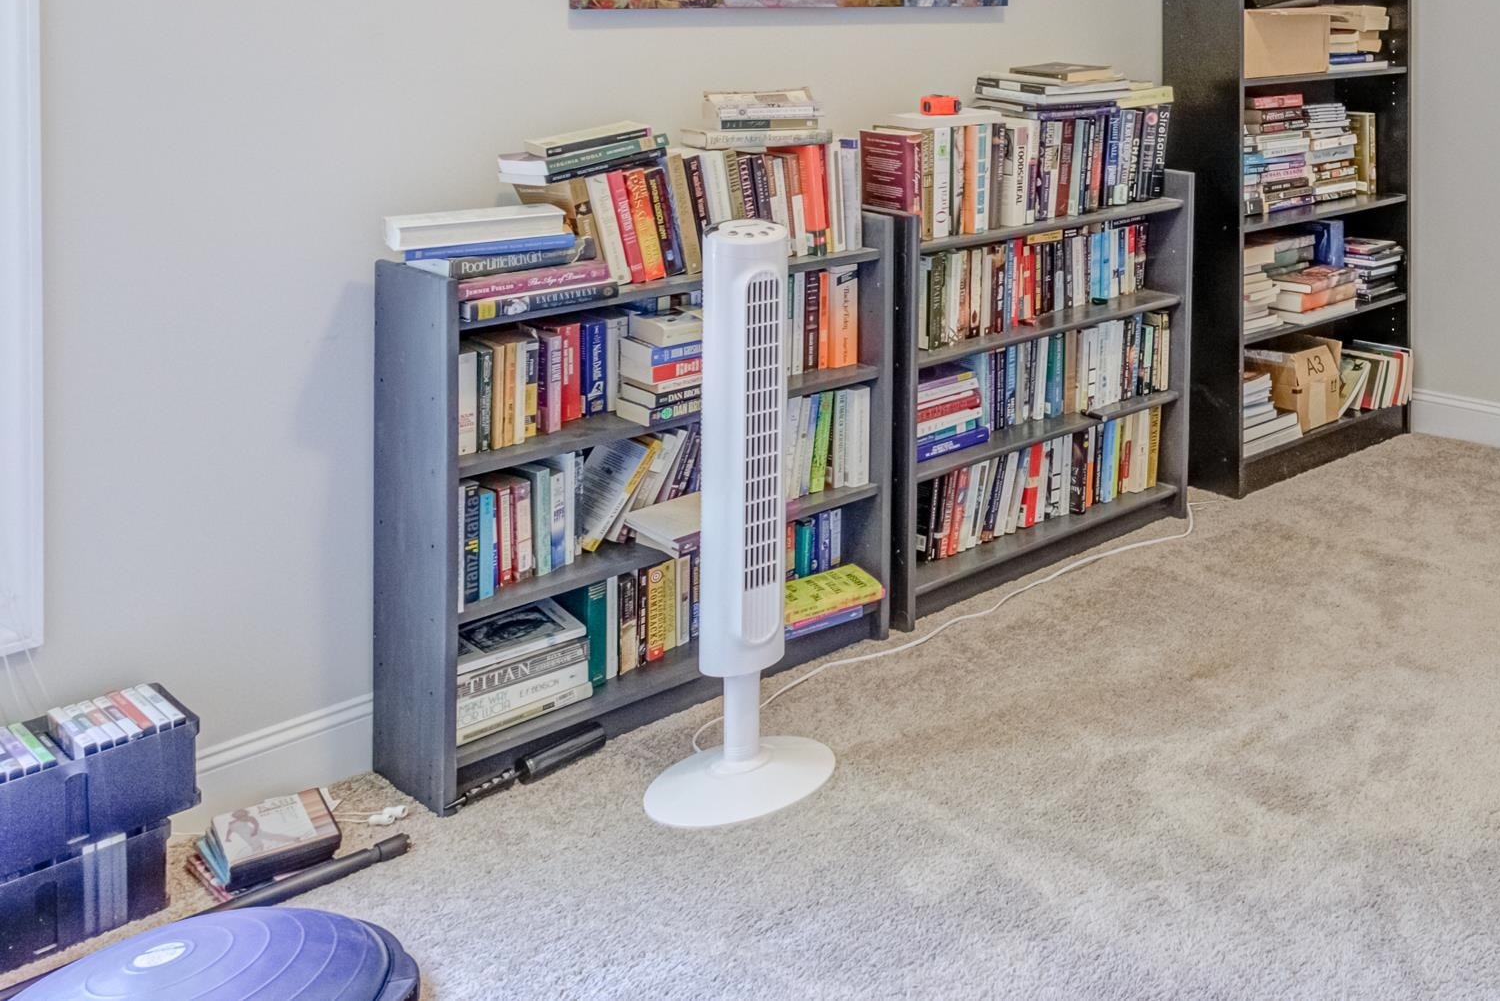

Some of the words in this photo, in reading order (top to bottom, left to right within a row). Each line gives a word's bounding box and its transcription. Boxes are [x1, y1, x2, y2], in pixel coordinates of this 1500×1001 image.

[1156, 110, 1170, 166] Streisand
[1017, 145, 1025, 175] FOODS
[1129, 137, 1140, 187] CHANEL
[461, 259, 486, 275] Poor
[486, 254, 507, 271] Little
[507, 252, 526, 269] Rich
[526, 250, 542, 266] Girl
[536, 287, 598, 305] ENCHANTMENT
[933, 283, 942, 310] PARK
[1306, 355, 1325, 376] A3
[668, 392, 683, 402] DAN
[683, 388, 702, 399] BROW
[1151, 407, 1160, 429] NEW
[465, 495, 479, 543] kafka
[465, 553, 478, 598] franz
[650, 587, 659, 646] COMEBACKS
[468, 661, 533, 694] TITAN
